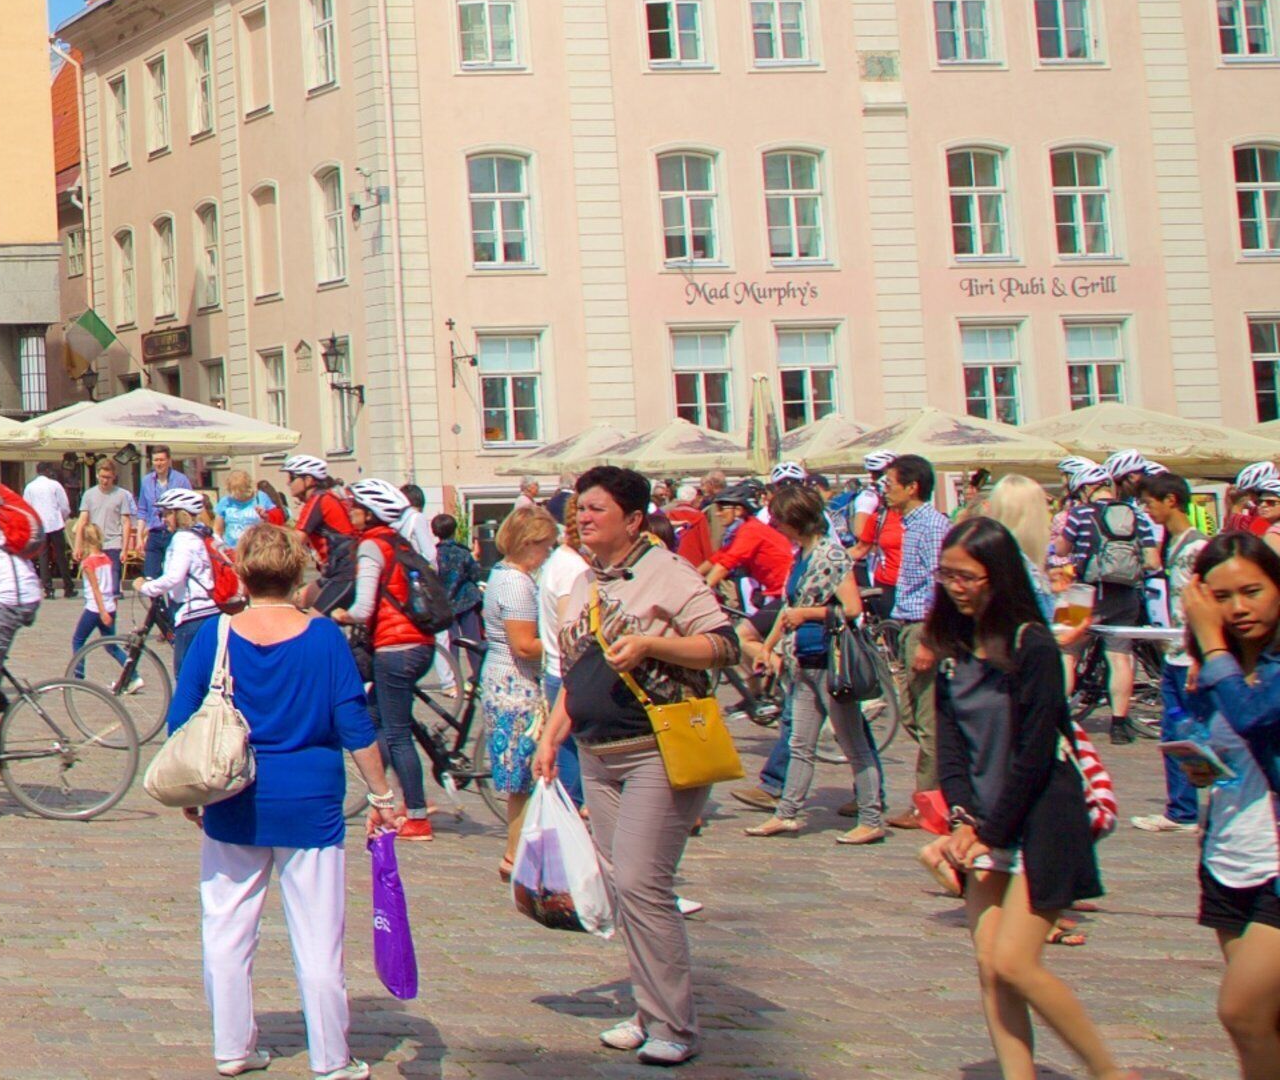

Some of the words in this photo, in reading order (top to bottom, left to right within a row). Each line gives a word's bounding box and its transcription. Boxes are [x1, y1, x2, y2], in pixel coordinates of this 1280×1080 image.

[684, 281, 730, 305] Mad
[734, 281, 819, 306] Murphy's
[999, 277, 1046, 303] Pubi
[1051, 276, 1068, 297] &
[1071, 275, 1117, 298] Grill
